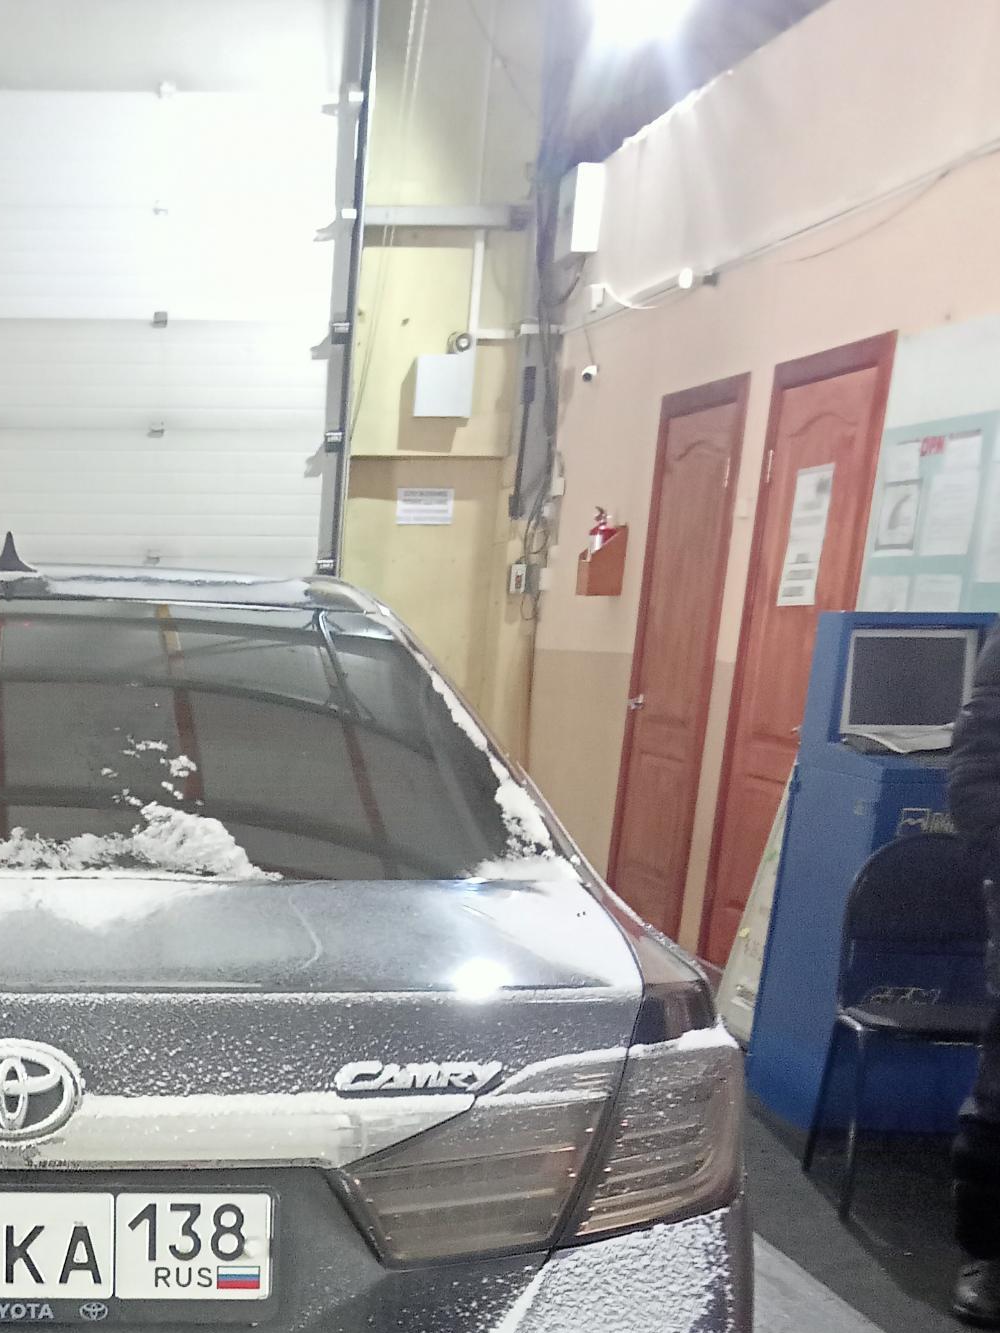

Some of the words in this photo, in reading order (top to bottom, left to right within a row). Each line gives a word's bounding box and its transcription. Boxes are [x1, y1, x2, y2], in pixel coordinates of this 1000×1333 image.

[334, 1060, 503, 1092] CAMRY
[127, 1202, 246, 1262] 138
[154, 1266, 213, 1288] RUS
